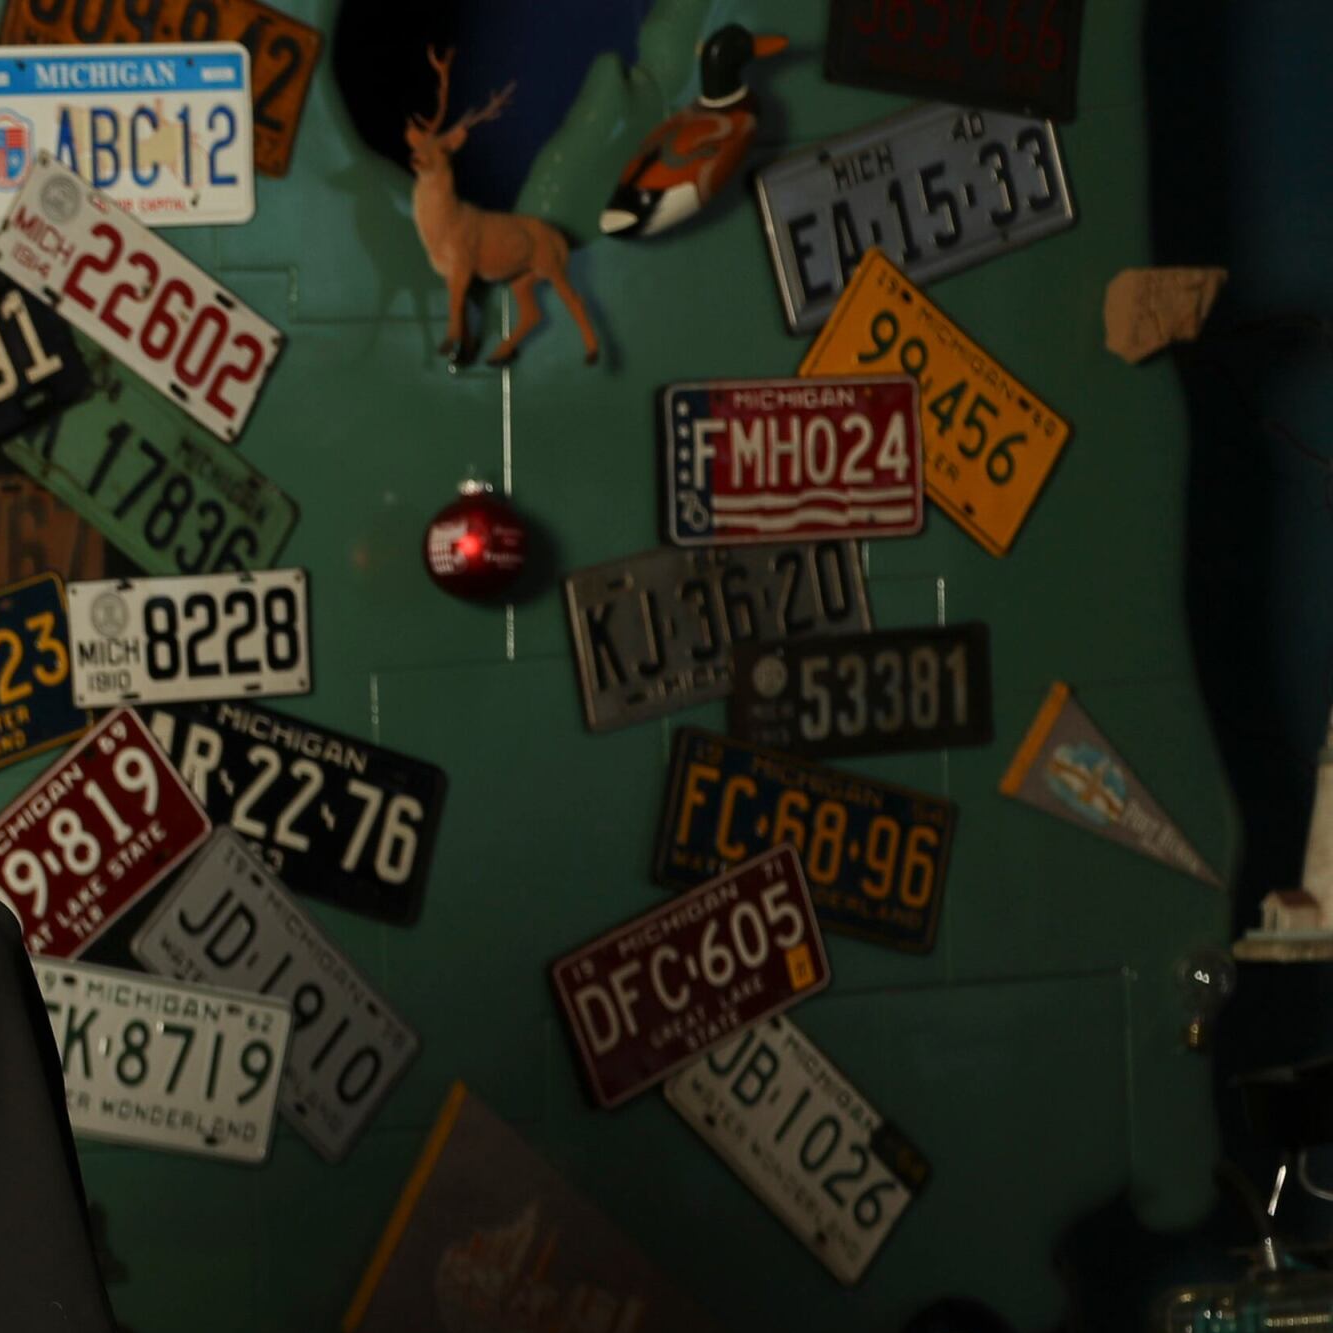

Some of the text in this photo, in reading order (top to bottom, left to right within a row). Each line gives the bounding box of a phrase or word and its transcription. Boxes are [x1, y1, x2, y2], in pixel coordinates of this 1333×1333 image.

[35, 60, 177, 89] MICHIGAN
[57, 104, 237, 189] ABC12
[832, 143, 895, 190] MICH
[12, 206, 74, 263] MICH
[63, 222, 264, 419] 22602
[734, 388, 856, 410] MICHIGAN
[691, 412, 910, 490] FMH024
[78, 641, 140, 668] MICH
[144, 588, 298, 680] 8228
[798, 640, 969, 743] 53381
[217, 702, 368, 773] MICHIGAN
[56, 877, 109, 934] LAKE
[107, 821, 169, 883] STATE
[617, 883, 739, 957] MICHIGAN
[85, 979, 222, 1023] MICHIGAN
[649, 1003, 709, 1049] GREAT
[686, 1013, 739, 1049] STATE
[99, 1097, 259, 1144] WONDERLAND
